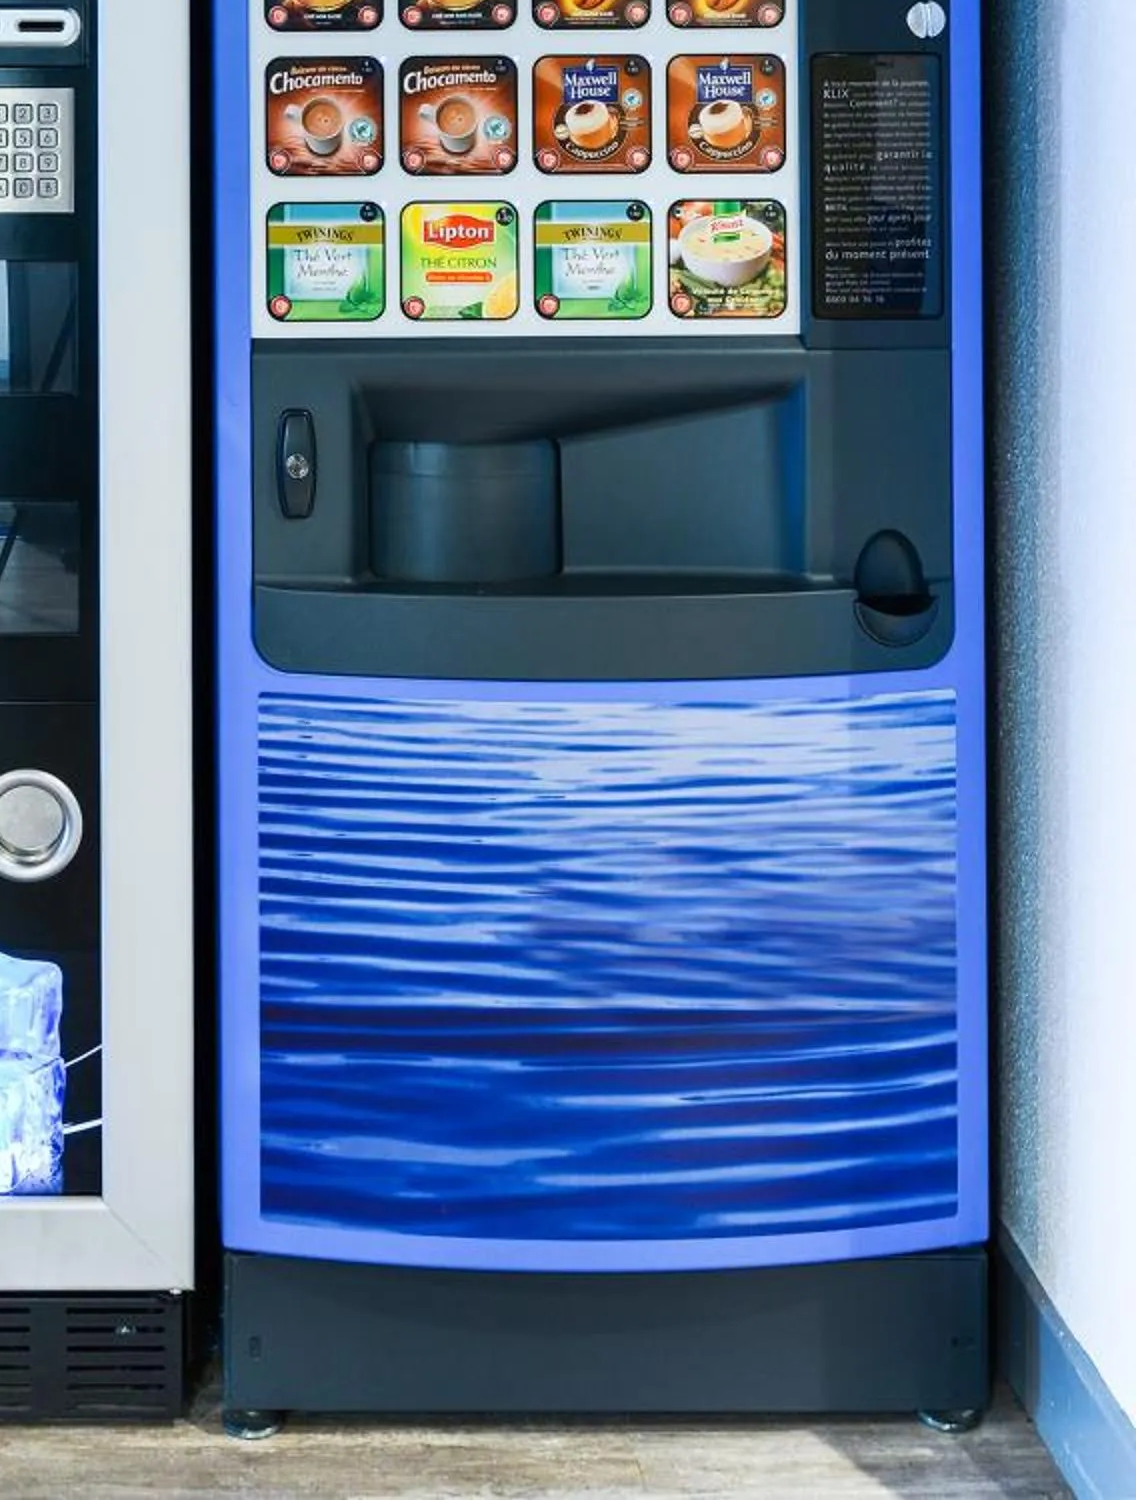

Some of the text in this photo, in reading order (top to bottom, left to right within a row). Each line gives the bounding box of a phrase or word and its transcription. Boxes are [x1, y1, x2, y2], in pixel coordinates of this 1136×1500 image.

[269, 71, 363, 95] Chocamento
[404, 71, 497, 94] Chocamento
[565, 72, 617, 86] Maxwell
[699, 71, 751, 85] Maxwell
[570, 85, 612, 99] House
[704, 86, 745, 99] House
[823, 88, 849, 99] KLIX
[296, 227, 353, 242] TWININGS
[429, 222, 489, 242] Lipton
